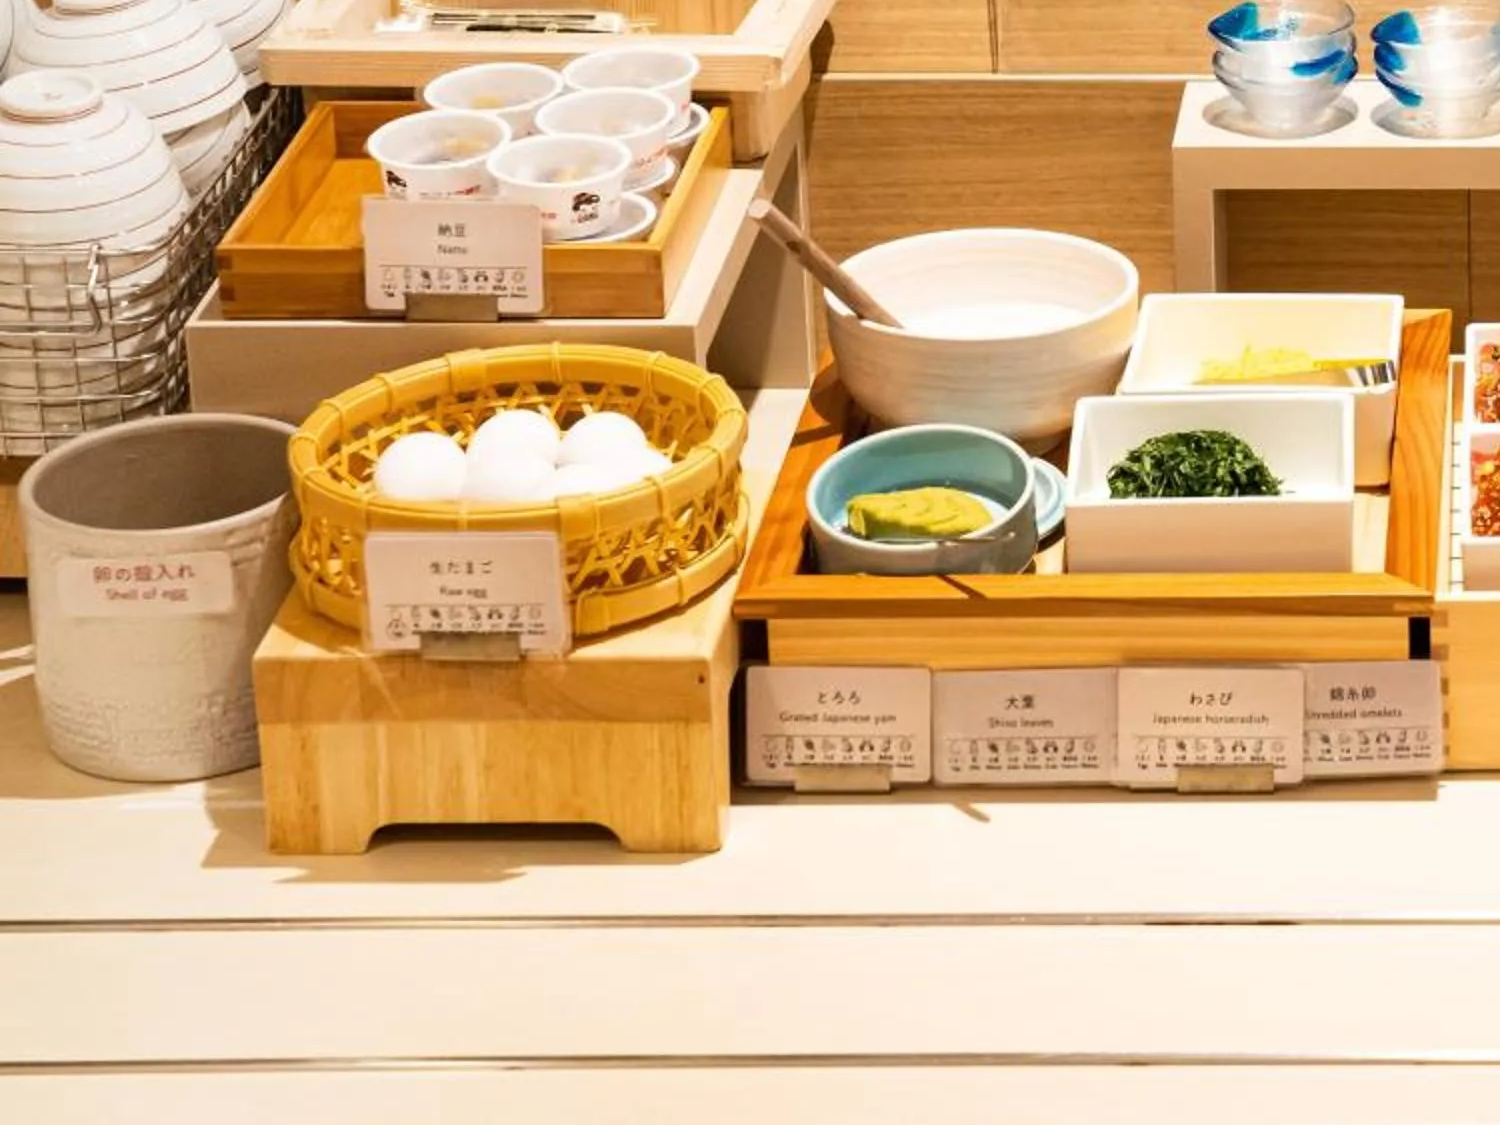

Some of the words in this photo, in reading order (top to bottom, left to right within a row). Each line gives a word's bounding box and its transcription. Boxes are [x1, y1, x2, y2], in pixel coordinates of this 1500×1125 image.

[817, 691, 862, 705] とろろ
[1189, 691, 1233, 706] わさび
[779, 711, 819, 723] Grated
[822, 712, 871, 724] Japanese
